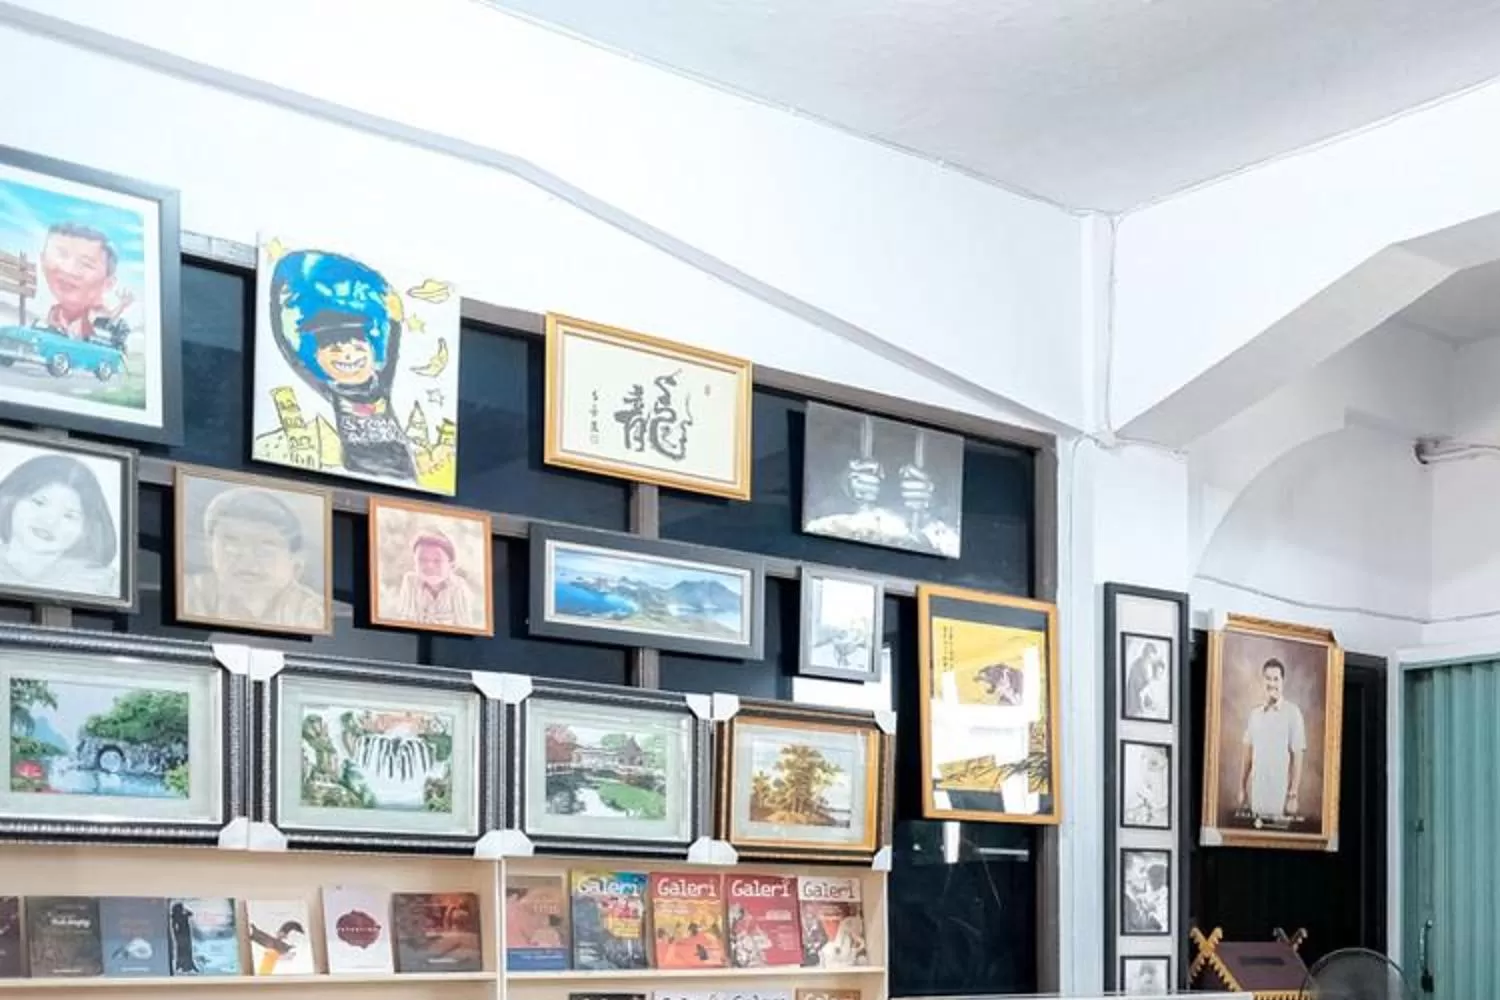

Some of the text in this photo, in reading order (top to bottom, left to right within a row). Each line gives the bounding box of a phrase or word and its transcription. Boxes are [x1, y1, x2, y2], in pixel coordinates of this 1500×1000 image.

[577, 874, 642, 897] Galeri
[656, 877, 717, 897] Galeri
[731, 878, 792, 898] Galeri
[803, 878, 855, 899] Galeri
